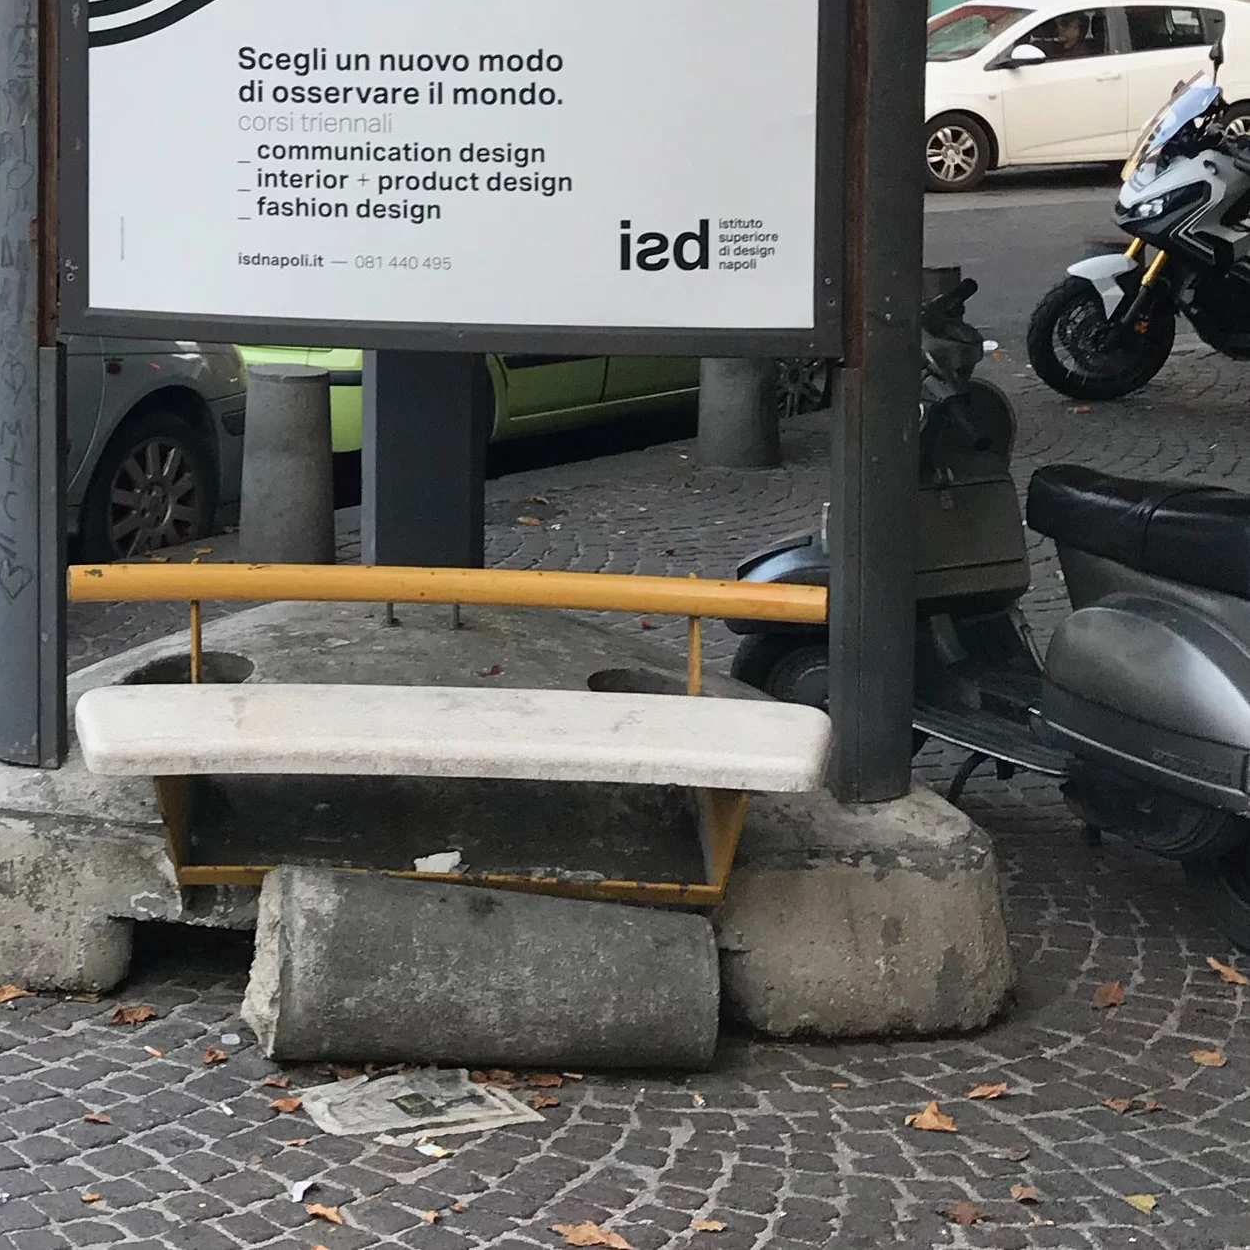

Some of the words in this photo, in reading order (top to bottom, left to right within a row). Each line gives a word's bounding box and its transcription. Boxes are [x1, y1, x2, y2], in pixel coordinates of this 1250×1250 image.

[239, 47, 326, 76] Scegli
[336, 54, 369, 71] un
[380, 54, 469, 71] nuovo
[480, 49, 563, 72] modo
[239, 80, 263, 102] di
[273, 86, 419, 104] osservare
[429, 82, 442, 104] il
[453, 82, 562, 105] mondo.
[239, 112, 293, 132] corsi
[301, 113, 392, 133] triennali
[258, 142, 451, 162] communication
[460, 143, 544, 168] design
[258, 168, 349, 189] interior
[379, 171, 479, 194] product
[487, 172, 571, 196] design
[257, 196, 348, 217] fashion
[356, 199, 440, 224] design
[719, 218, 762, 229] istituto
[719, 232, 778, 244] superiore
[239, 253, 323, 268] isdnapoli.it
[355, 255, 382, 269] 081
[387, 254, 419, 271] 440
[422, 255, 452, 271] 495
[719, 246, 730, 256] di
[733, 246, 775, 258] design
[719, 259, 756, 271] napoli
